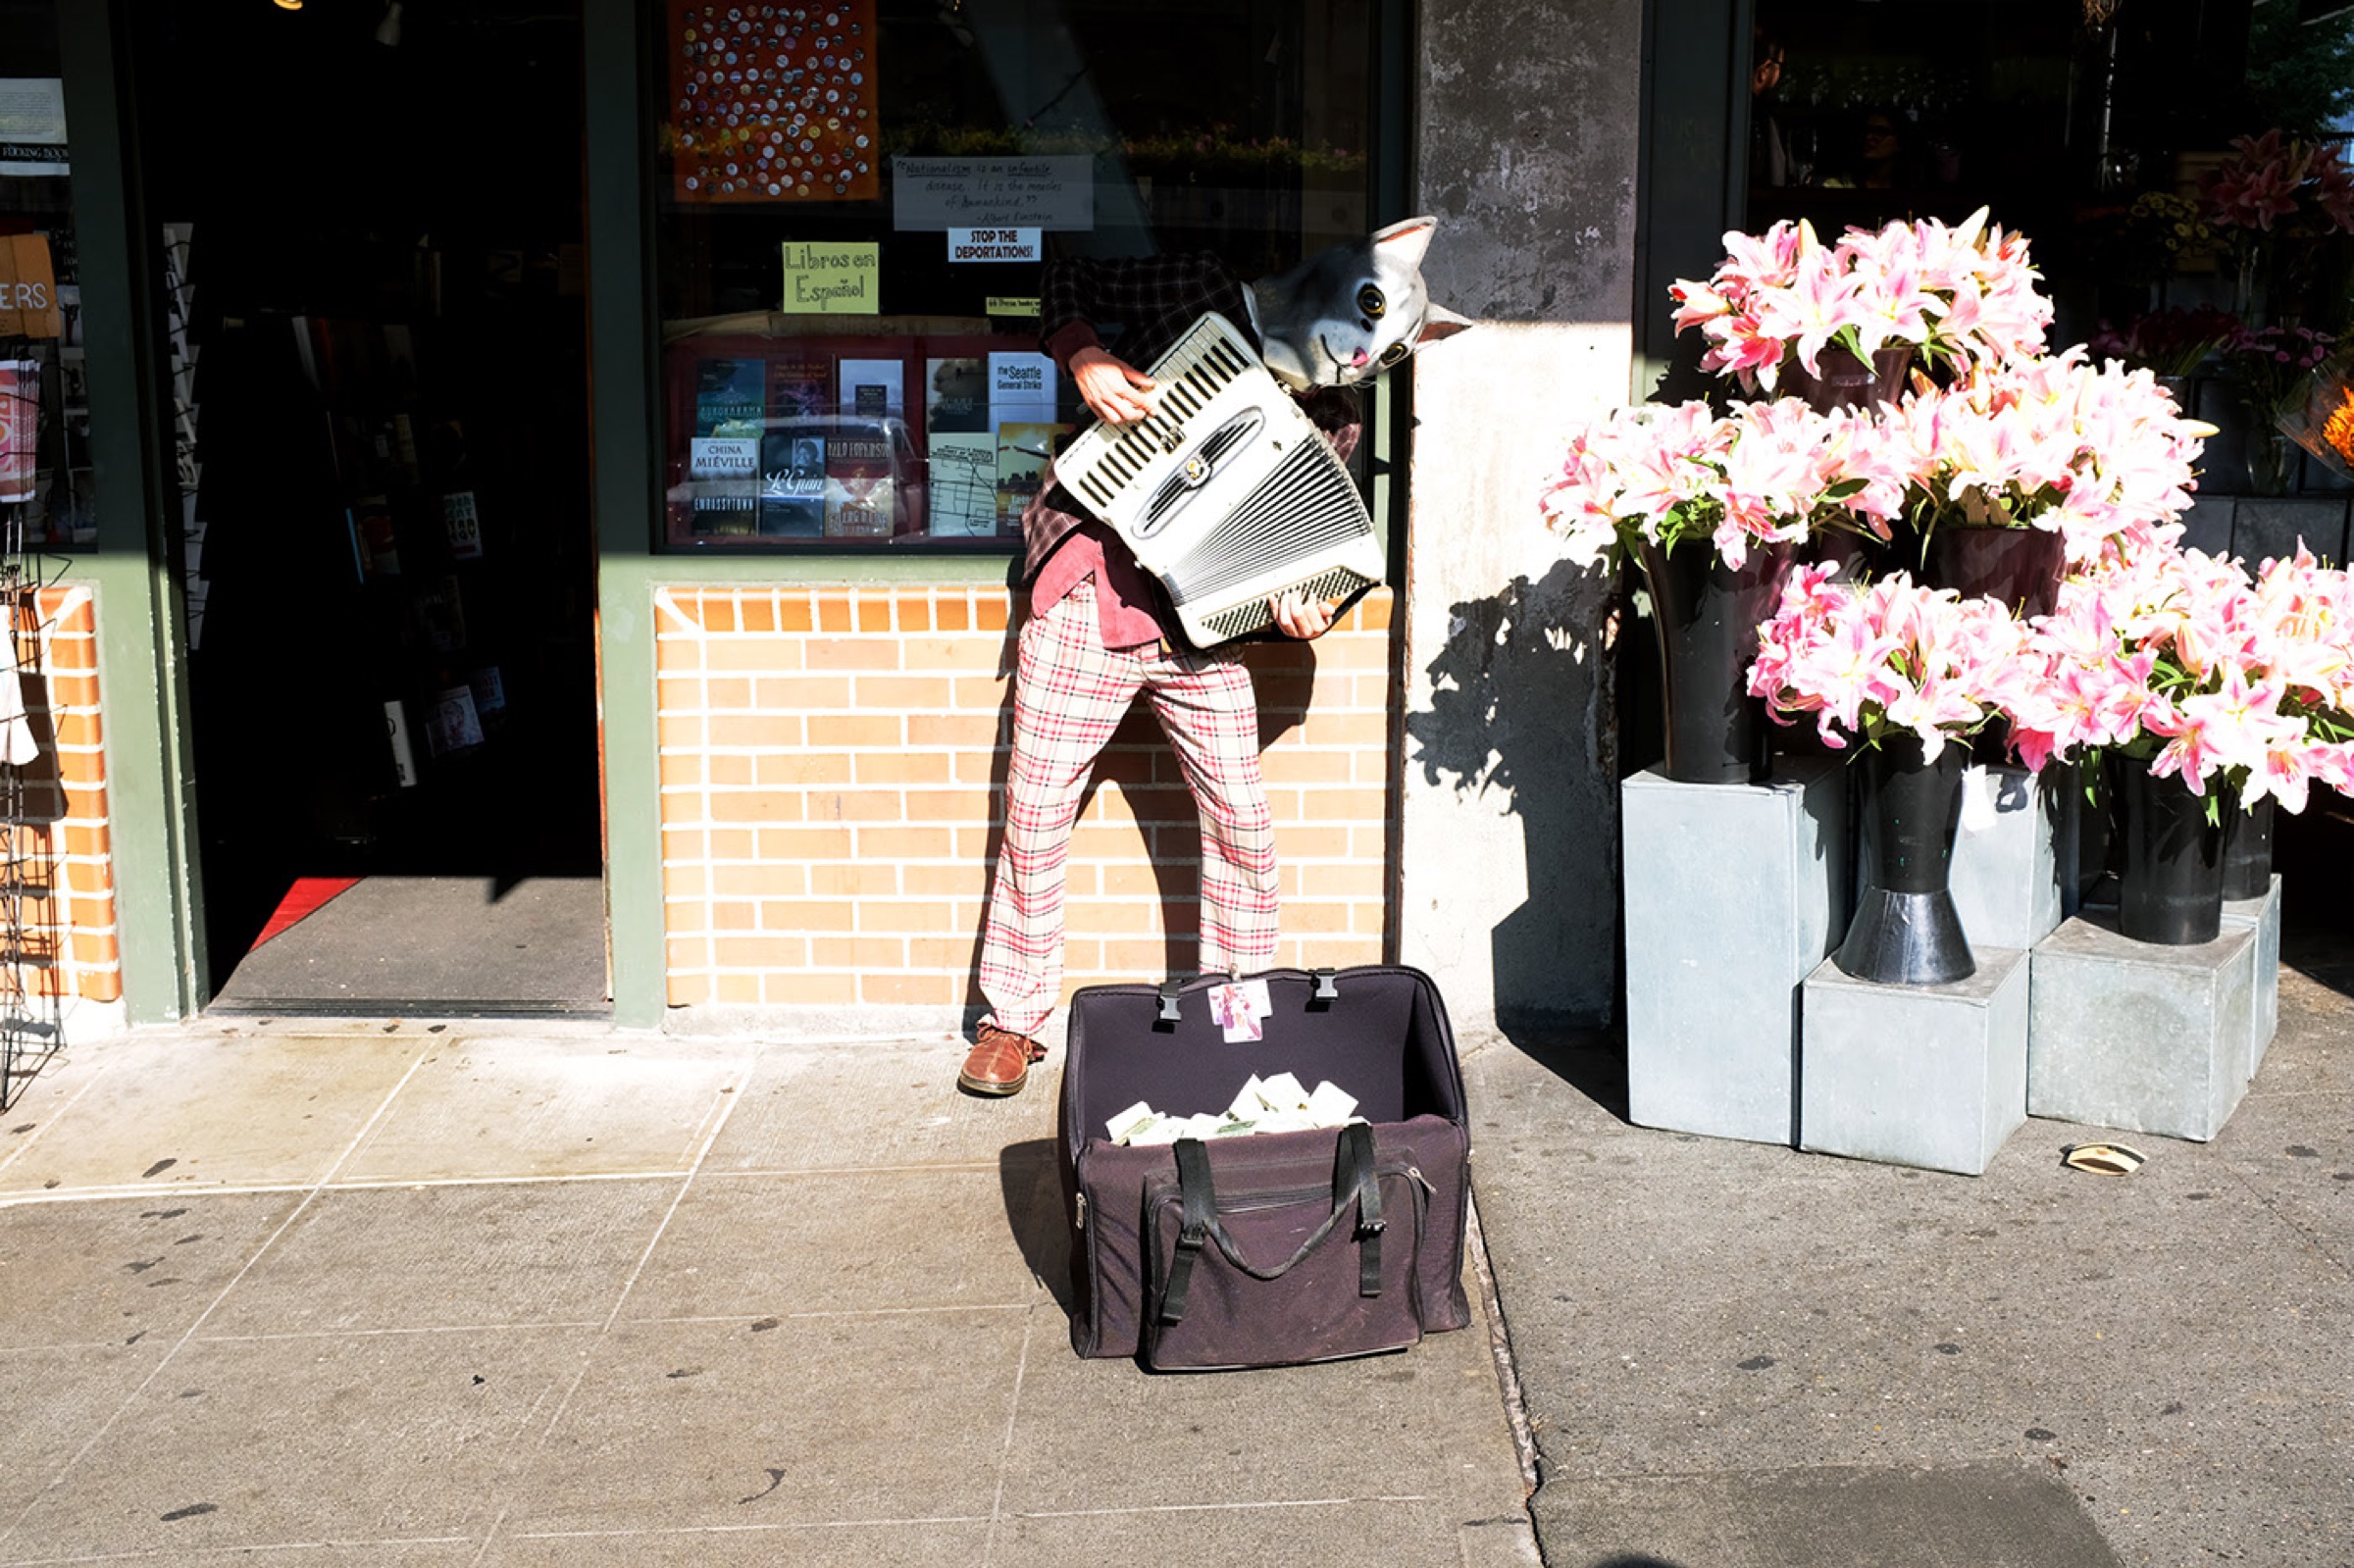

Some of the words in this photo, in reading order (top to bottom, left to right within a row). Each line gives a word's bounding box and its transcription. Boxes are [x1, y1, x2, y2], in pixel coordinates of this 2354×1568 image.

[977, 163, 986, 174] is
[991, 165, 1002, 174] an
[971, 230, 996, 243] STOP
[998, 230, 1017, 243] THE
[785, 244, 849, 269] Libros
[852, 253, 876, 268] en
[955, 246, 1033, 259] DEPORTATIONS!
[795, 275, 864, 311] Español
[1008, 365, 1042, 380] Seattle
[998, 379, 1021, 390] General
[707, 444, 742, 455] CHINA
[694, 455, 754, 468] MIÉVILLE
